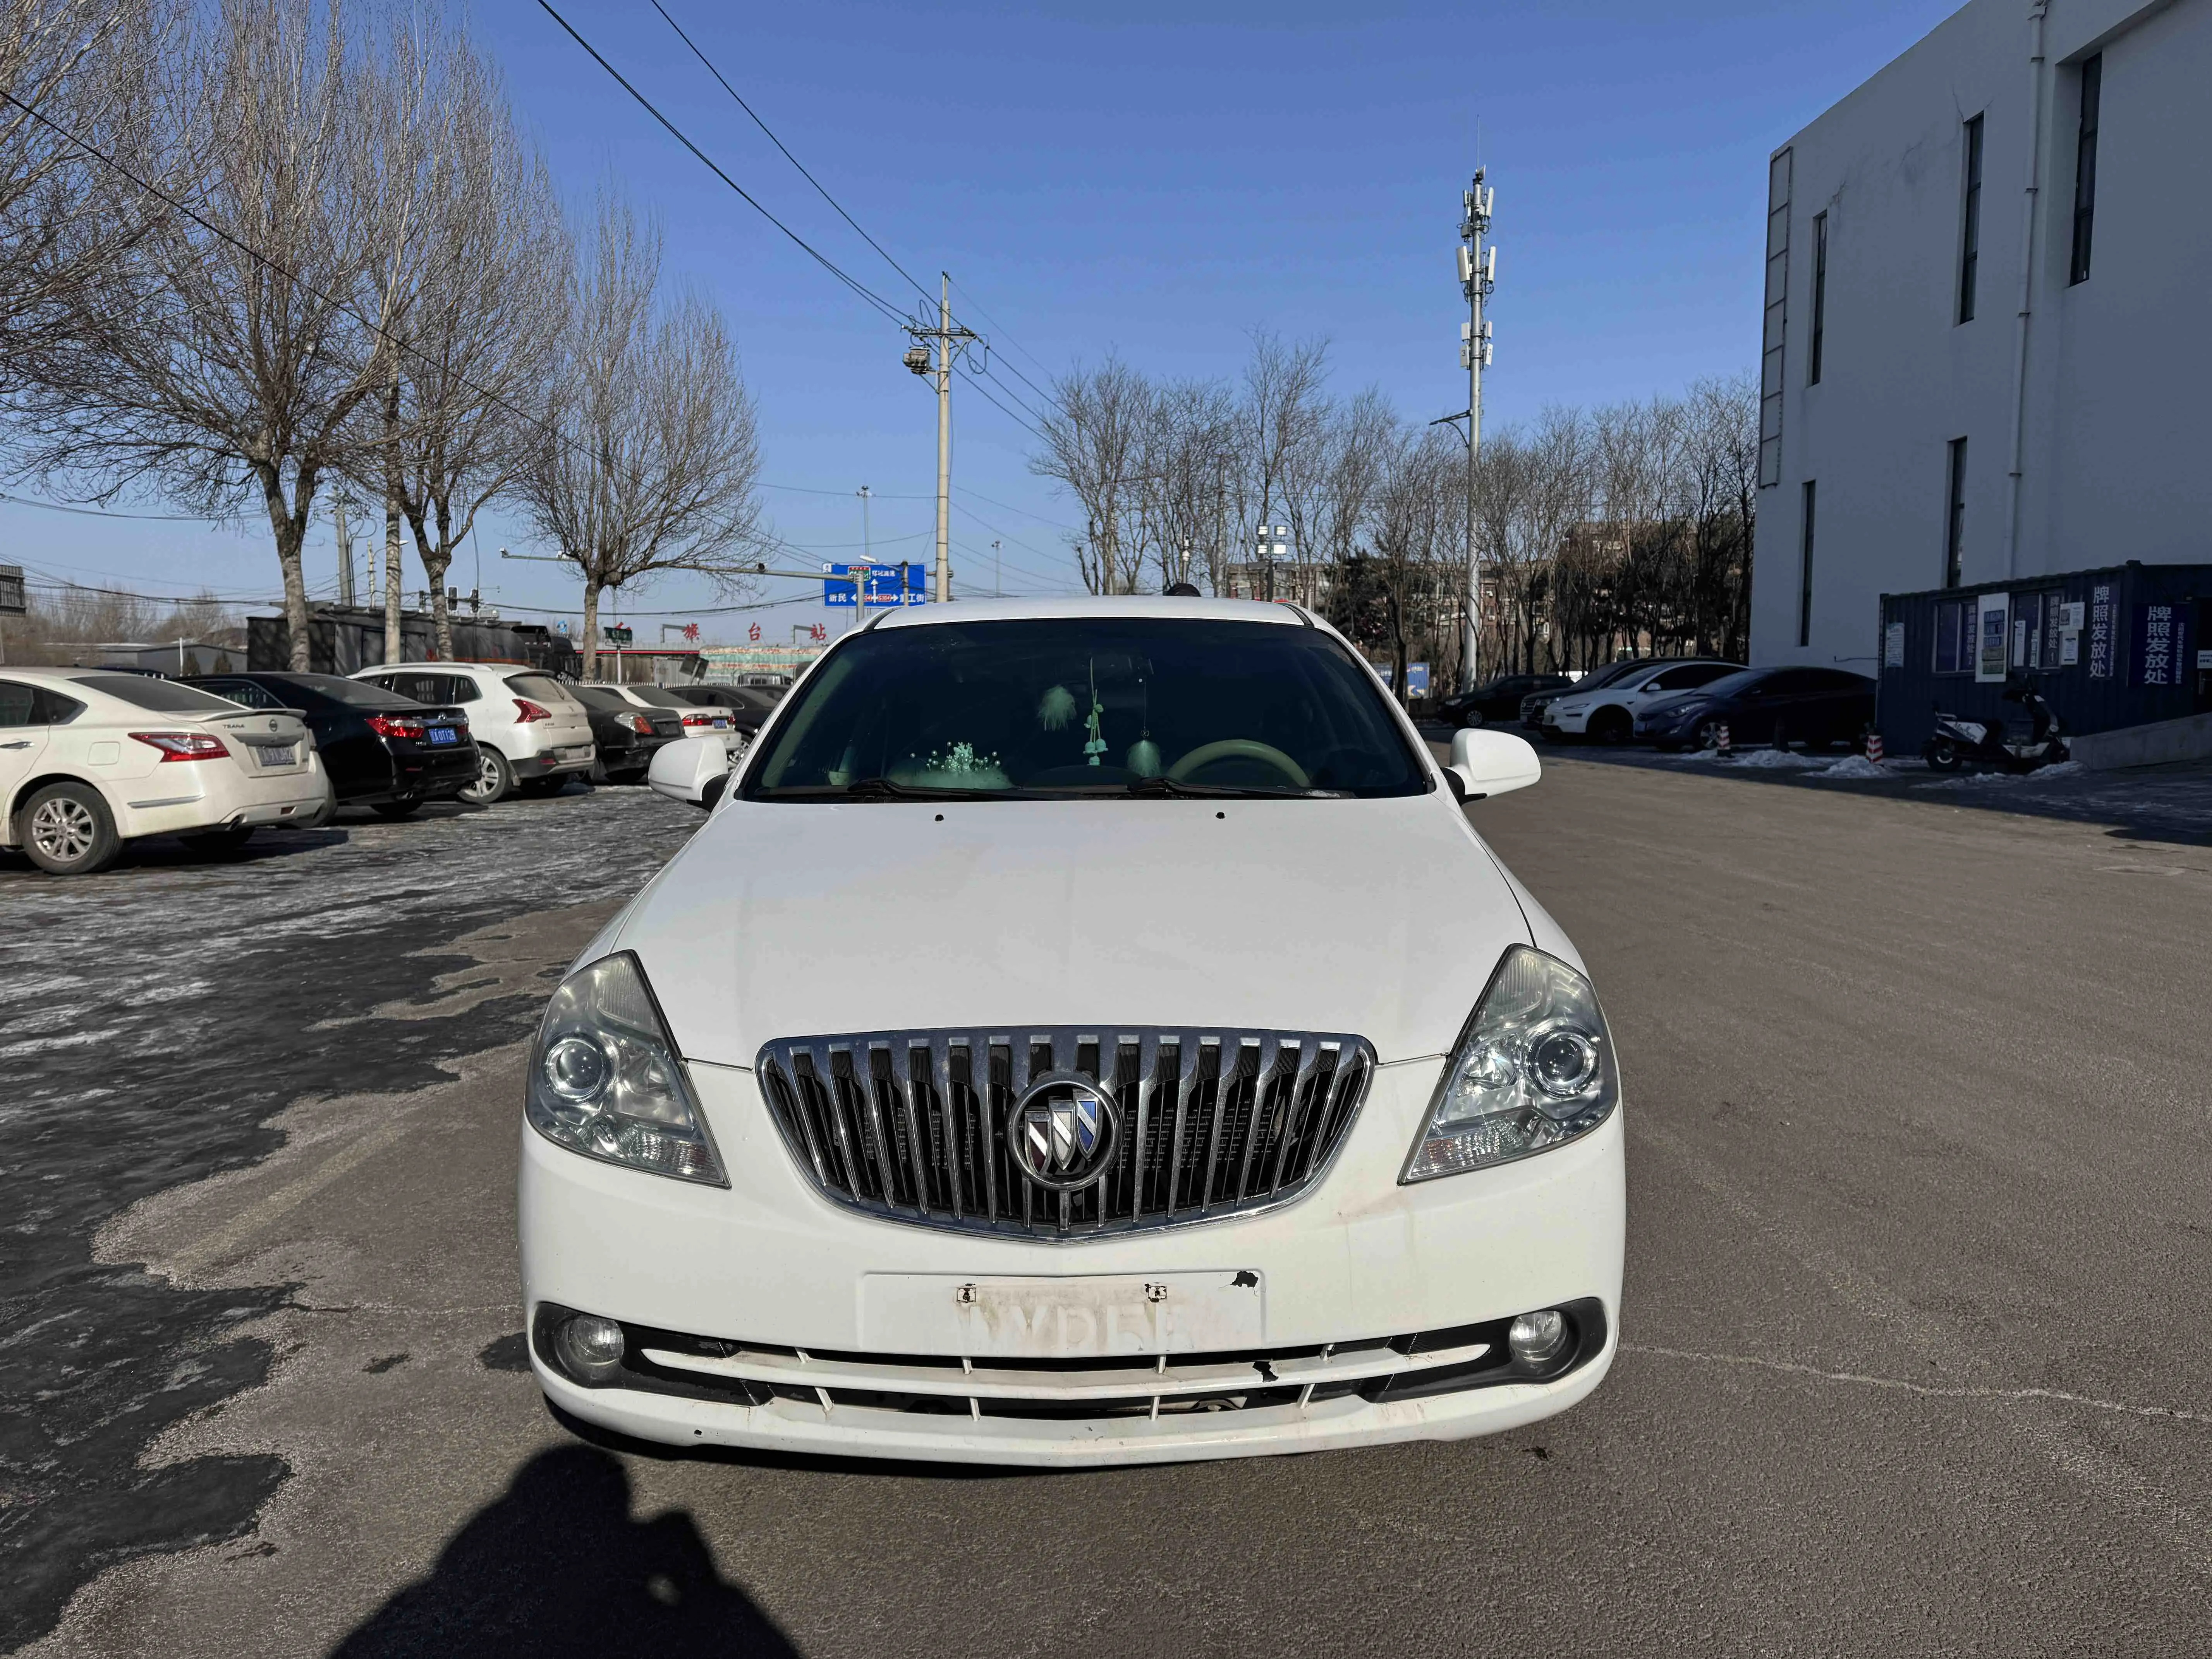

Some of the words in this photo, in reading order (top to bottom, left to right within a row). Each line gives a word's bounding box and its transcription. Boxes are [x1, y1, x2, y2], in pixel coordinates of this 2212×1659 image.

[829, 593, 847, 602] 新民
[2090, 585, 2109, 678] 牌照发放处
[2144, 606, 2172, 684] 牌照发放处
